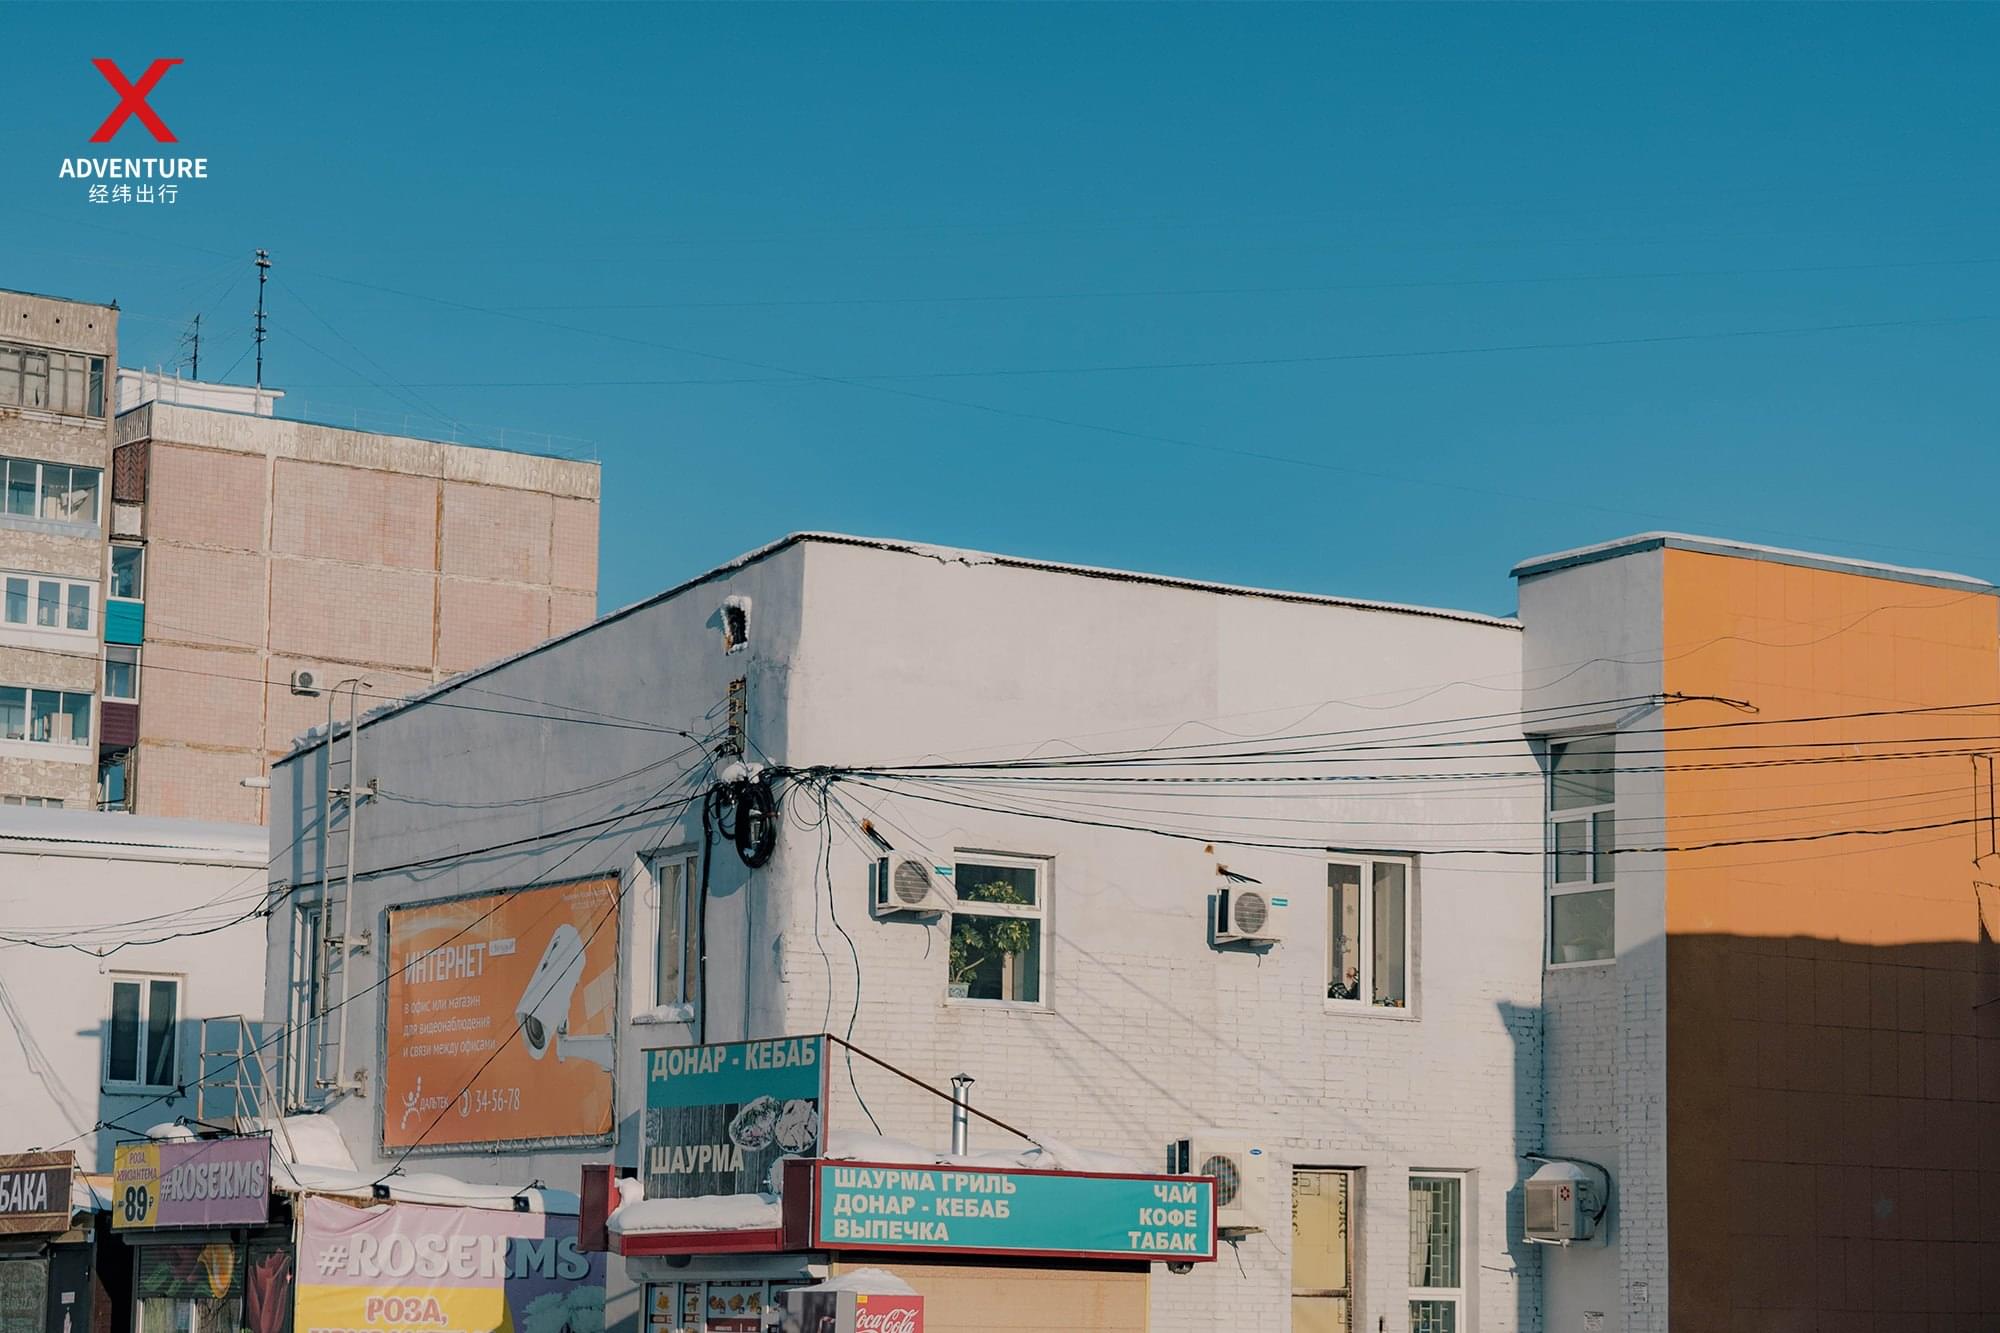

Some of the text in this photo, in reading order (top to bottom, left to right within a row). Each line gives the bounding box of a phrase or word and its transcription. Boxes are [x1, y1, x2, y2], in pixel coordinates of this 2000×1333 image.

[405, 943, 486, 985] ИНТЕРНЕТ
[652, 1047, 726, 1082] ДОНАР
[745, 1038, 815, 1070] КЕБАБ
[476, 1087, 521, 1113] 34-56-78
[651, 1144, 744, 1174] ШАУРМА
[160, 1160, 265, 1202] #ROSEKMS
[834, 1168, 1017, 1194] ШАУРМА ГРИЛЬ
[1154, 1182, 1197, 1204] ЧАЙ
[125, 1186, 148, 1222] 89
[834, 1194, 916, 1216] ДОНАР
[936, 1197, 1010, 1218] КЕБАБ
[1139, 1207, 1197, 1227] КОФЕ
[834, 1219, 949, 1241] ВЫПЕЧКА
[1128, 1231, 1197, 1251] ТАБАК
[316, 1232, 592, 1281] #ROSEKMS
[366, 1296, 448, 1325] РОЗА,
